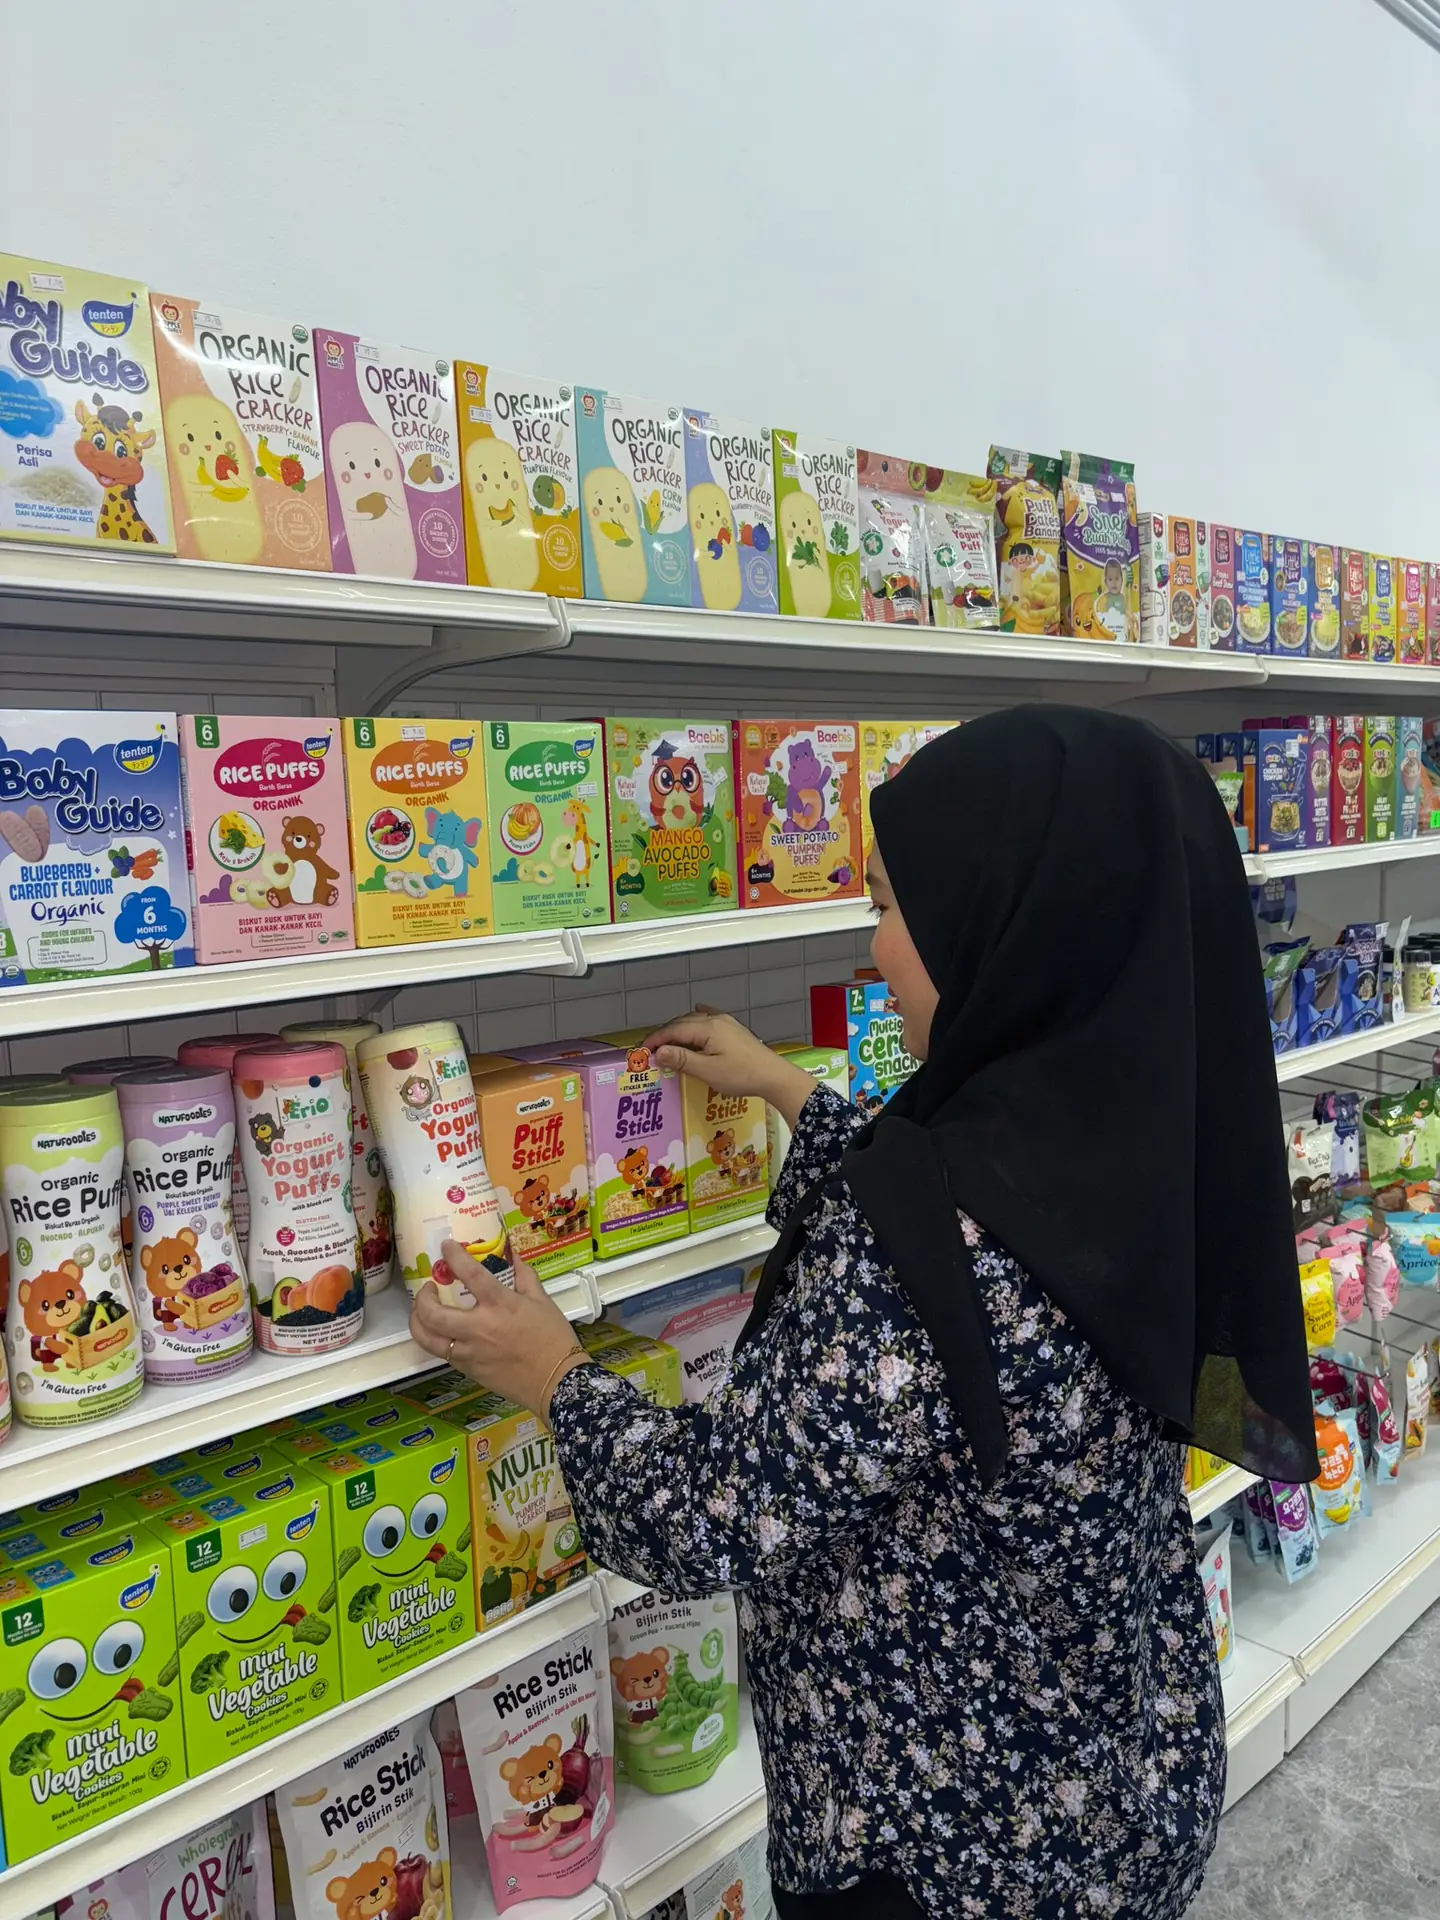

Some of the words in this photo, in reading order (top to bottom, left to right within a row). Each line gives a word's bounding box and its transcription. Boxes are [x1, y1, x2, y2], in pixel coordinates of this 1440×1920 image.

[88, 309, 123, 320] tenten
[9, 329, 147, 391] Guide
[243, 423, 289, 436] STRAWBERRY
[293, 431, 318, 447] BANANA
[17, 444, 52, 457] Perisa
[288, 439, 320, 459] FLAVOUR
[425, 442, 450, 459] POTATO
[18, 456, 38, 467] Asli
[523, 464, 549, 475] PUMPKIN
[662, 488, 682, 504] CORN
[202, 724, 213, 742] 6
[360, 726, 370, 741] 6
[496, 729, 504, 743] 6
[689, 729, 725, 744] Baebis
[818, 729, 852, 743] Baebis
[121, 745, 154, 759] tenten
[220, 763, 263, 784] RICE
[266, 763, 320, 778] PUFFS
[376, 764, 415, 782] RICE
[417, 761, 464, 777] PUFFS
[510, 765, 543, 781] RICE
[545, 761, 586, 776] PUFFS
[0, 760, 95, 805] Baby
[253, 795, 303, 811] ORGANIK
[405, 792, 449, 807] ORGANIK
[535, 791, 573, 803] ORGANIK
[56, 797, 163, 832] Guide
[652, 830, 703, 845] MANGO
[771, 833, 799, 844] SWEET
[804, 832, 839, 843] POTATO
[644, 845, 710, 864] AVOCADO
[787, 844, 824, 855] PUMPKIN
[793, 855, 819, 866] PUFFS
[658, 863, 699, 879] PUFFS
[10, 883, 57, 900] CARROT
[31, 900, 104, 925] Organic
[143, 906, 156, 925] 6
[239, 917, 262, 925] BISKUT
[285, 914, 306, 922] UNTUK
[137, 925, 167, 934] MONTHS
[255, 923, 303, 933] KANAK-KANAK
[852, 989, 862, 1006] 7+
[869, 1018, 903, 1036] Multig
[859, 1035, 906, 1062] cer
[631, 1073, 648, 1083] FREE
[618, 1092, 662, 1120] Puff
[706, 1098, 748, 1122] Stick
[158, 1108, 212, 1123] NATUFOODIES
[421, 1111, 478, 1140] Yogur
[514, 1116, 563, 1149] Puff
[616, 1114, 663, 1139] Stick
[38, 1131, 96, 1149] NATUFOODIES
[273, 1131, 334, 1155] Organic
[162, 1145, 214, 1163] Organic
[261, 1144, 345, 1177] Yogurt
[513, 1141, 564, 1170] Stick
[41, 1172, 99, 1191] Organic
[132, 1167, 188, 1194] Rice
[274, 1172, 341, 1201] Puffs
[10, 1196, 71, 1224] Rice
[157, 1200, 180, 1208] PURPLE
[292, 1203, 305, 1211] with
[307, 1199, 322, 1208] black
[459, 1203, 479, 1215] Apple
[263, 1248, 285, 1256] Peach,
[288, 1247, 322, 1256] Avocado
[1398, 1260, 1437, 1270] Aprico
[1308, 1310, 1332, 1324] Sweet
[1312, 1321, 1332, 1334] Corn
[173, 1344, 201, 1353] Gluten
[203, 1343, 220, 1353] Free
[41, 1379, 53, 1390] I'm
[54, 1385, 86, 1395] Gluten
[87, 1383, 107, 1393] Free
[432, 1463, 451, 1478] tenten
[354, 1482, 368, 1496] 12
[515, 1496, 546, 1519] PUMPKIN
[522, 1505, 546, 1528] CARROT
[289, 1516, 311, 1534] tenten
[196, 1540, 212, 1557] 12
[124, 1582, 149, 1601] tenten
[389, 1577, 429, 1612] mini
[14, 1612, 33, 1629] 12
[362, 1585, 456, 1649] Vegetable
[636, 1612, 668, 1627] Bijirin
[672, 1607, 691, 1619] Stik
[394, 1624, 430, 1648] Cookies
[239, 1642, 286, 1681] mini
[208, 1650, 318, 1722] Vegetable
[493, 1676, 542, 1720] Rice
[545, 1646, 593, 1687] Stick
[245, 1692, 288, 1720] Cookies
[525, 1693, 557, 1719] Bijirin
[559, 1683, 577, 1700] Stik
[226, 1724, 245, 1737] Biskut
[508, 1733, 522, 1745] Apple
[528, 1715, 550, 1732] Beetroot
[66, 1719, 120, 1761] mini
[343, 1726, 400, 1770] NATUFOODIES
[30, 1728, 158, 1804] Vegetable
[74, 1772, 123, 1802] Cookies
[320, 1784, 376, 1837] Rice
[377, 1745, 426, 1795] Stick
[52, 1806, 74, 1821] Biskut
[356, 1803, 392, 1834] Bijirin
[395, 1787, 414, 1808] Stik
